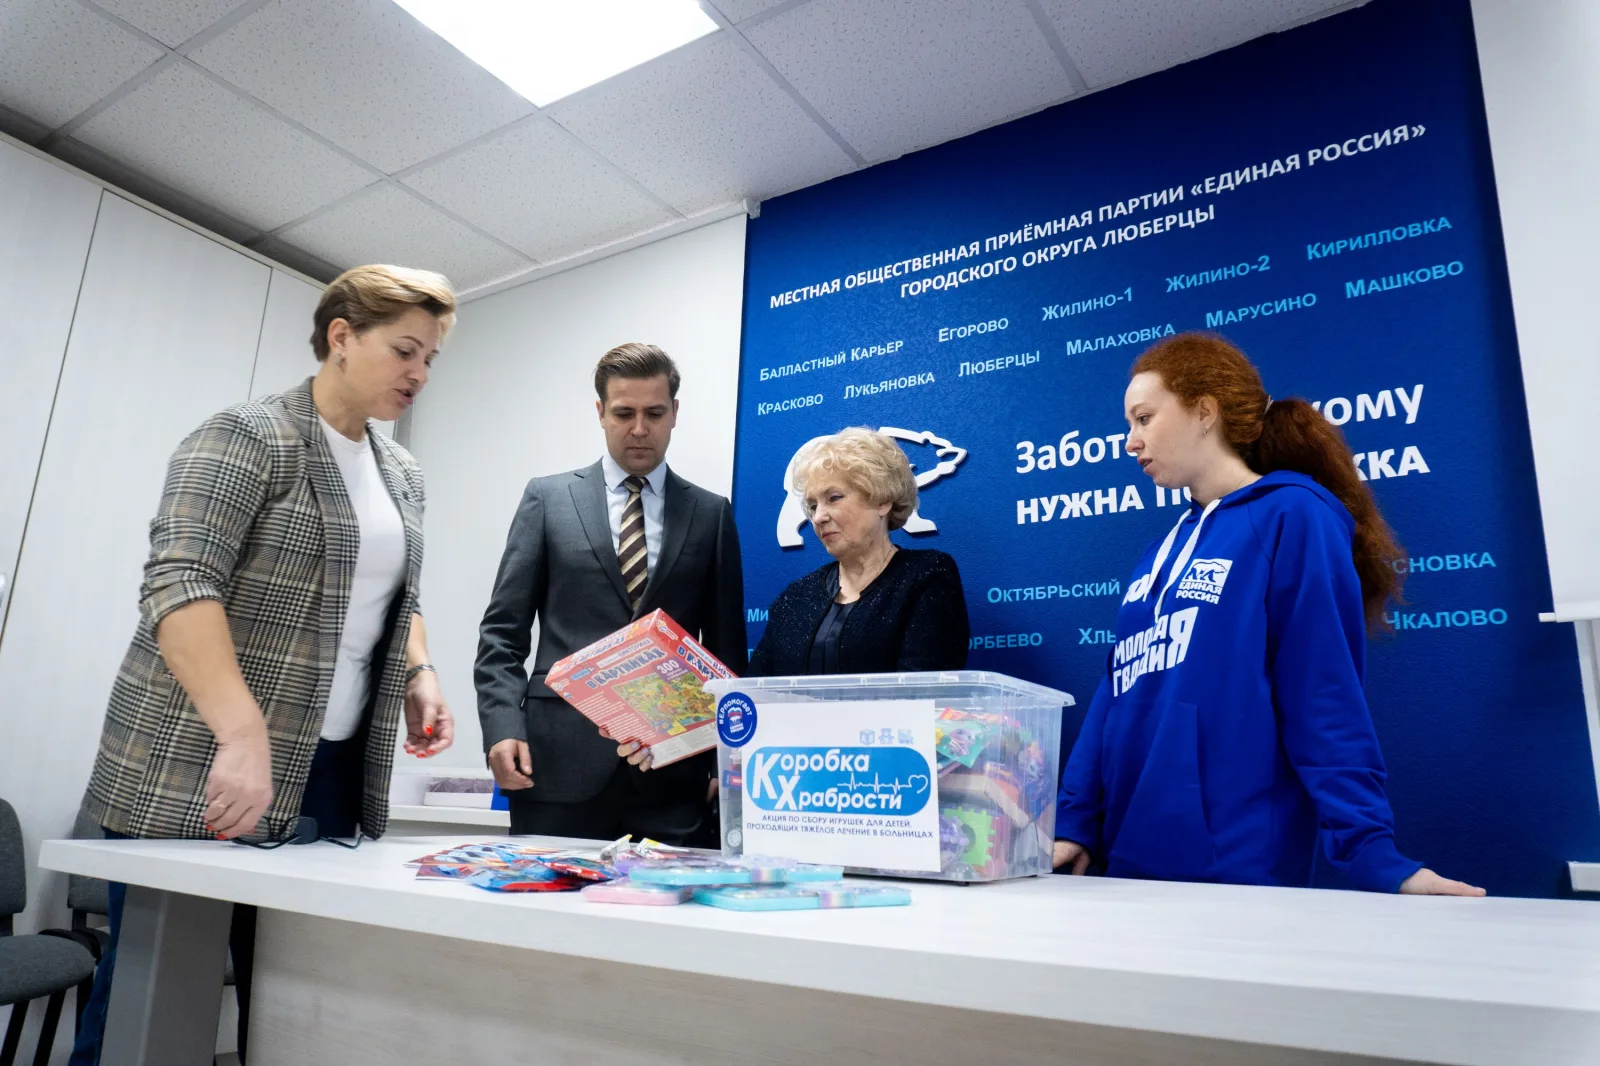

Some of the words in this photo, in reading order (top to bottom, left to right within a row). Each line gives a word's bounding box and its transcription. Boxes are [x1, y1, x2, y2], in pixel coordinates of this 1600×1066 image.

[769, 278, 841, 309] МЕСТНАЯ
[844, 241, 980, 290] ОБЩЕСТВЕННАЯ
[984, 209, 1093, 253] ПРИЁМНАЯ
[1098, 184, 1184, 222] ПАРТИИ
[1190, 153, 1301, 197] «ЕДИНАЯ
[1307, 122, 1427, 167] РОССИЯ»
[900, 256, 1018, 299] ГОРОДСКОГО
[1022, 235, 1097, 268] ОКРУГА
[1102, 204, 1215, 248] ЛЮБЕРЦЫ
[1016, 484, 1145, 525] НУЖНА
[1175, 589, 1220, 605] РОССИЯ
[1178, 580, 1223, 596] ЕДИНАЯ
[592, 646, 668, 686] КАРТИНКАХ
[656, 659, 680, 675] 300
[752, 748, 870, 800] Коробка
[773, 774, 902, 813] Храбрости
[746, 822, 799, 832] ПРОХОДЯЩИХ
[837, 827, 871, 836] ЛЕЧЕНИЕ
[880, 829, 934, 838] БОЛЬНИЦАХ
[762, 814, 787, 823] АКЦИЯ
[788, 815, 800, 823] ПО
[801, 816, 827, 824] СБОРУ
[829, 817, 864, 826] ИГРУШЕК
[866, 819, 883, 827] ДЛЯ
